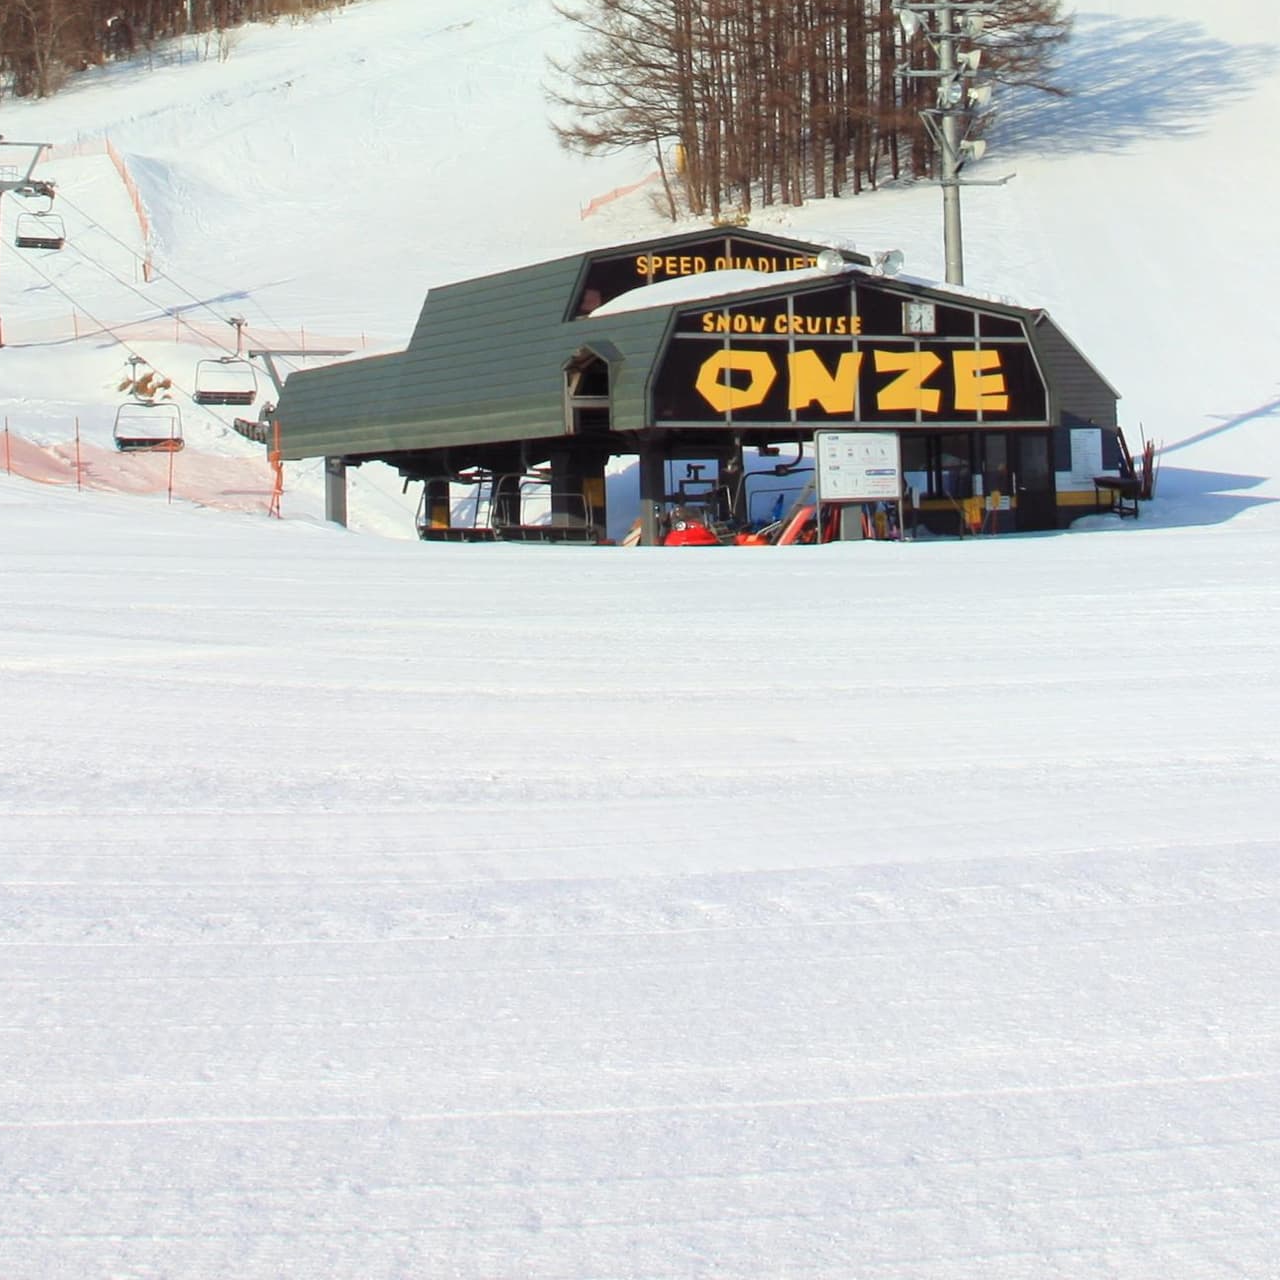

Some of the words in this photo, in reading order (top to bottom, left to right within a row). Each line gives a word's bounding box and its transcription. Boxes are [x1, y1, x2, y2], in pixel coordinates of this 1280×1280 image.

[636, 256, 706, 275] SPEED
[702, 312, 766, 333] SNOW
[774, 314, 862, 335] CRUISE
[695, 349, 1008, 413] ONZE
